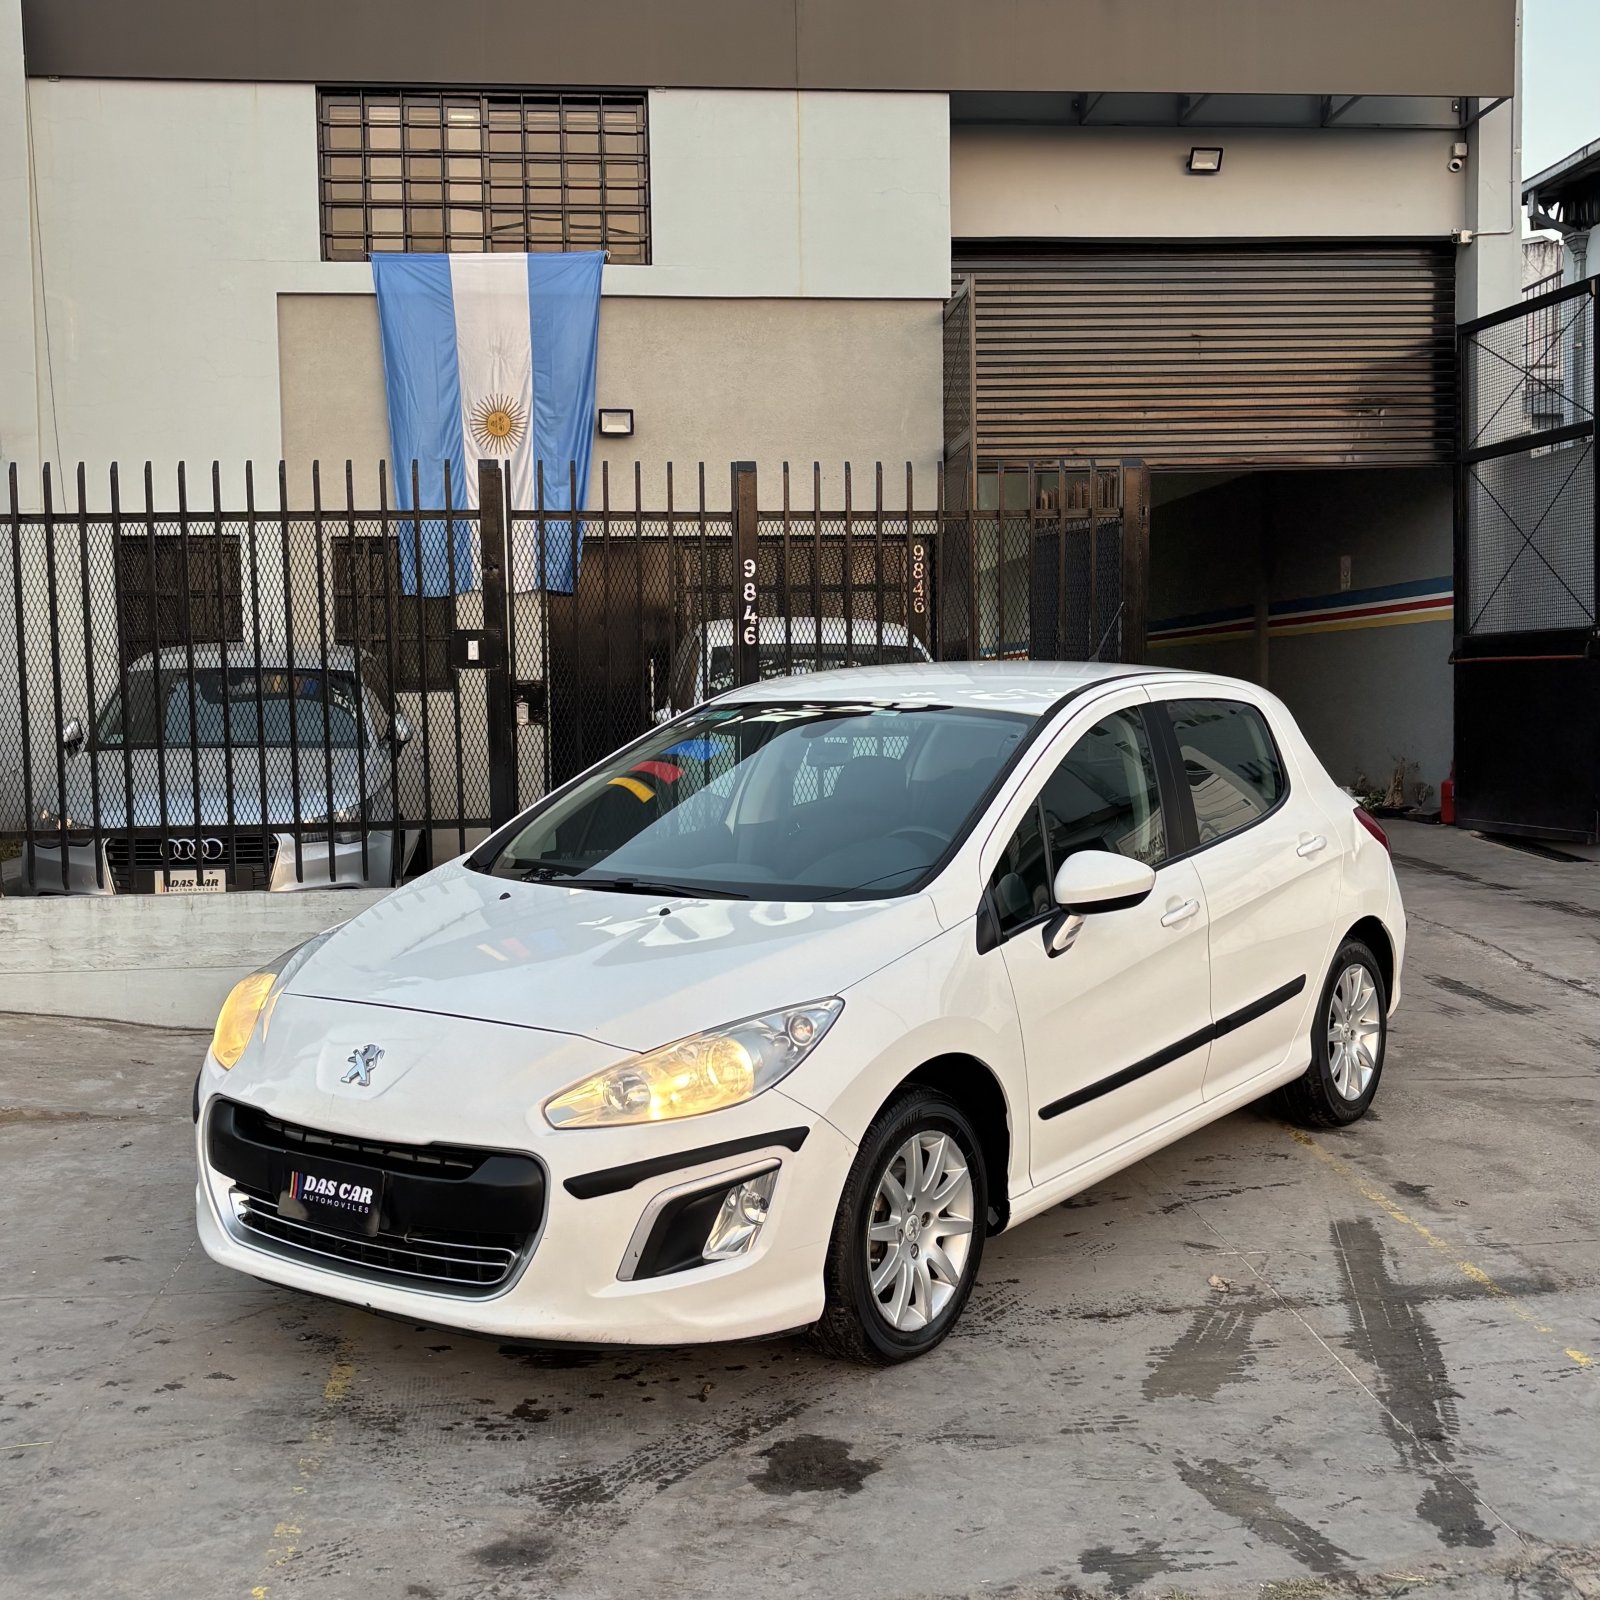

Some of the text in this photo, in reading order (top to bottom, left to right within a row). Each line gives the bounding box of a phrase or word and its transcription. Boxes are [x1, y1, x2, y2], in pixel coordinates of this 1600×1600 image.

[913, 544, 925, 613] 9846
[743, 558, 758, 645] 9846
[171, 879, 219, 887] DAS AR
[303, 1175, 373, 1205] DAS CAR
[303, 1193, 369, 1214] AUTOMOVILES
